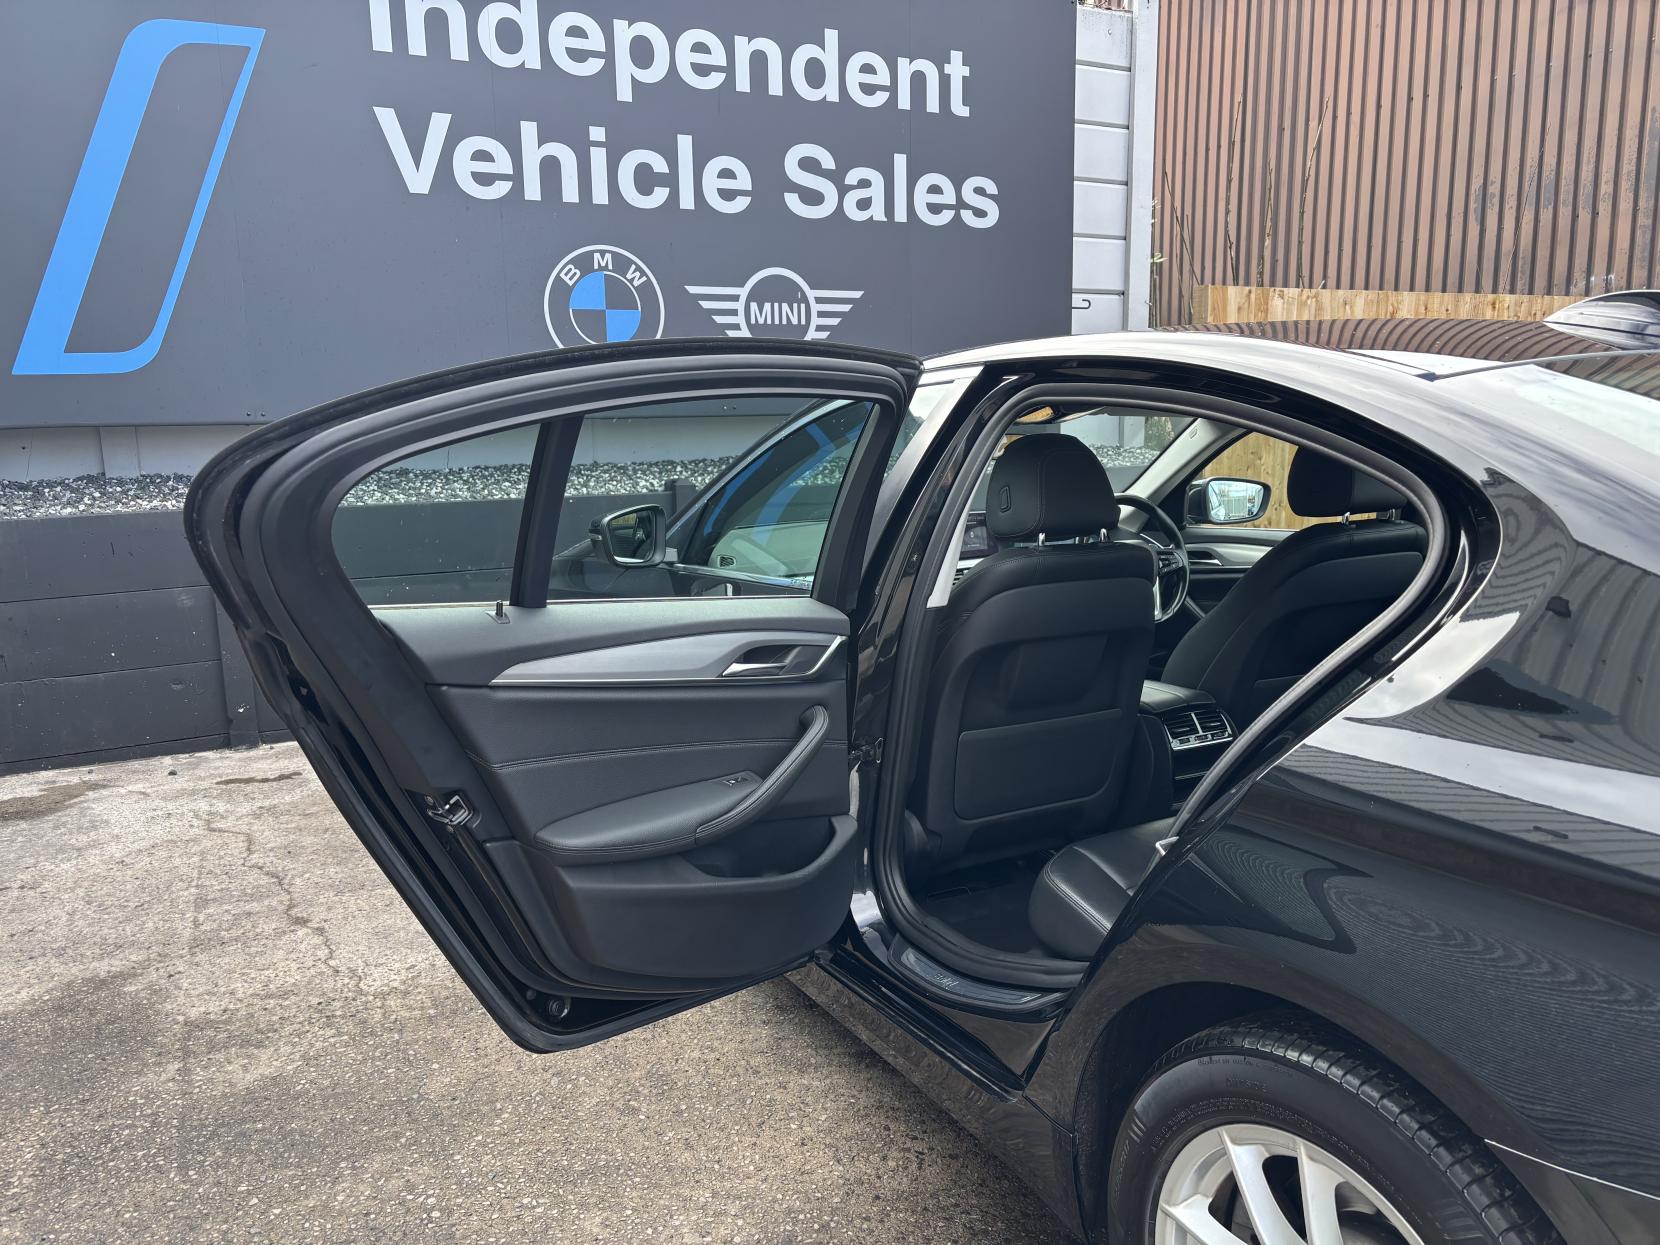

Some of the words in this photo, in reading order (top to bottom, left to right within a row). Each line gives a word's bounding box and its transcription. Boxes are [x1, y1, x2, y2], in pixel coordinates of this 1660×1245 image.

[369, 0, 970, 117] Independent
[373, 106, 752, 214] Vehicle
[783, 143, 1000, 229] Sales
[559, 252, 648, 287] BMW
[750, 302, 806, 326] MINI
